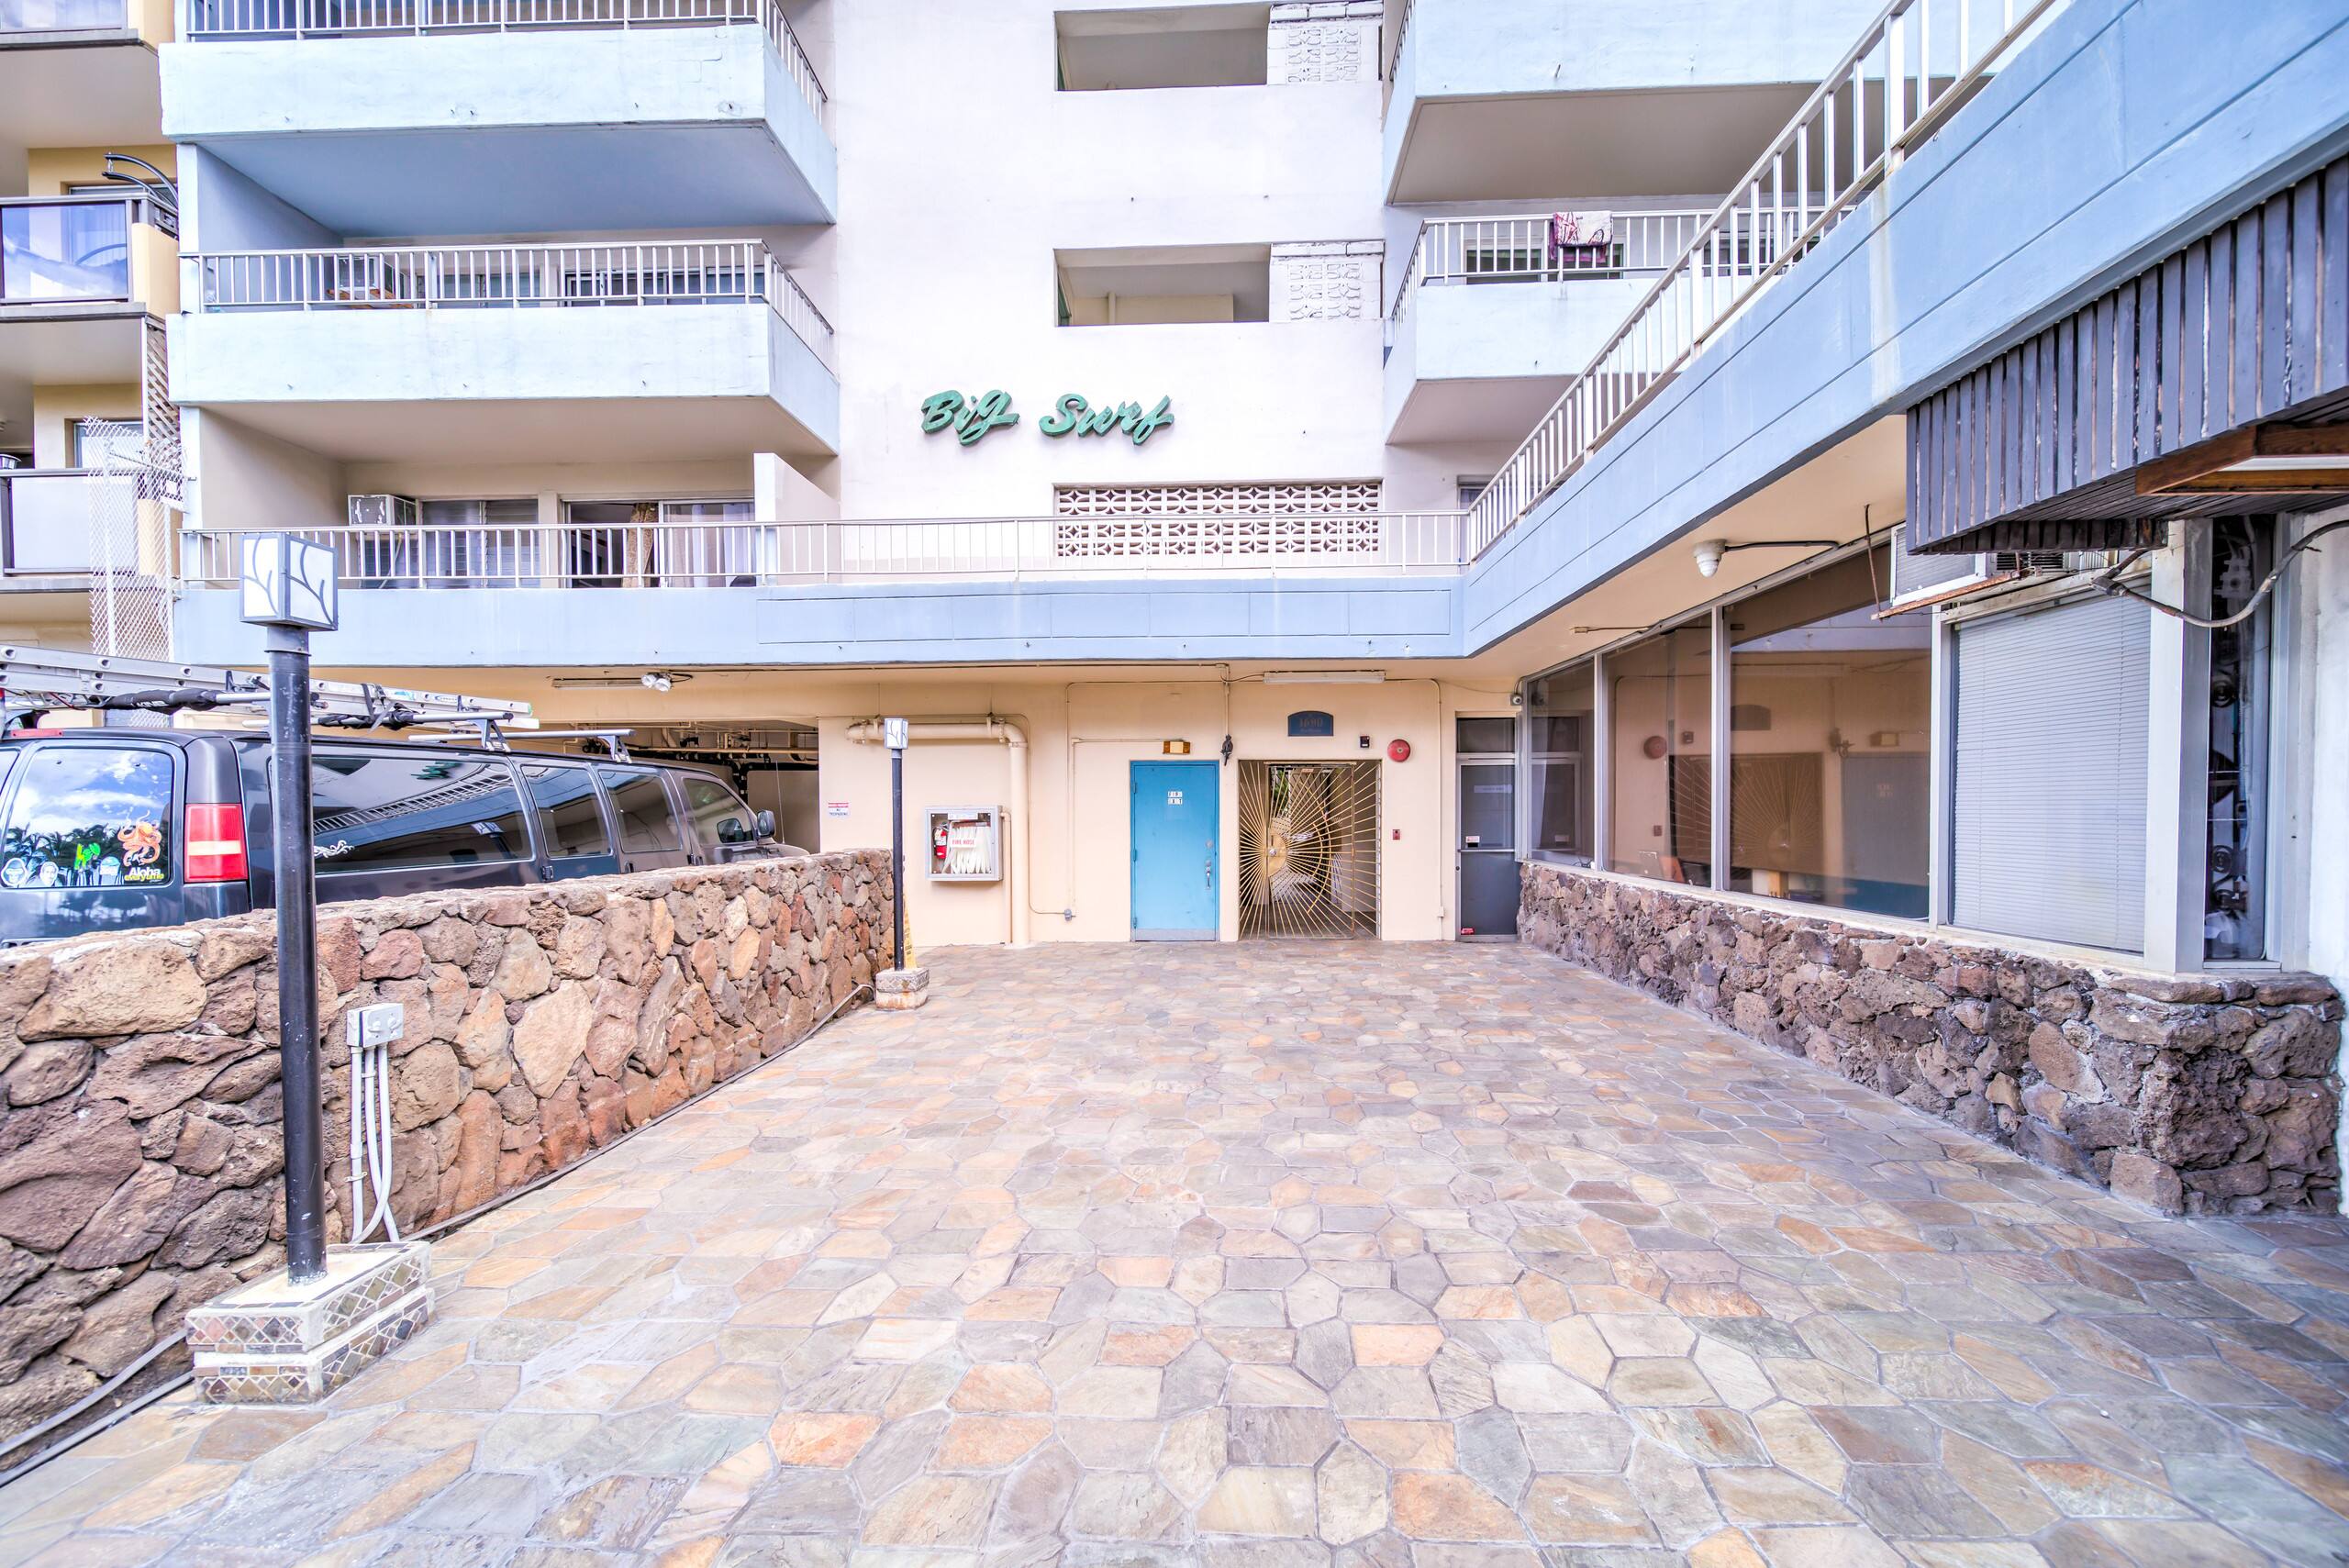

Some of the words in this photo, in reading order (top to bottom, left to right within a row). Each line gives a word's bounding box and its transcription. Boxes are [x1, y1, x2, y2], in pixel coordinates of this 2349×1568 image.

[920, 389, 1020, 447] Big
[1039, 393, 1175, 446] Surf
[128, 866, 161, 876] Aloha
